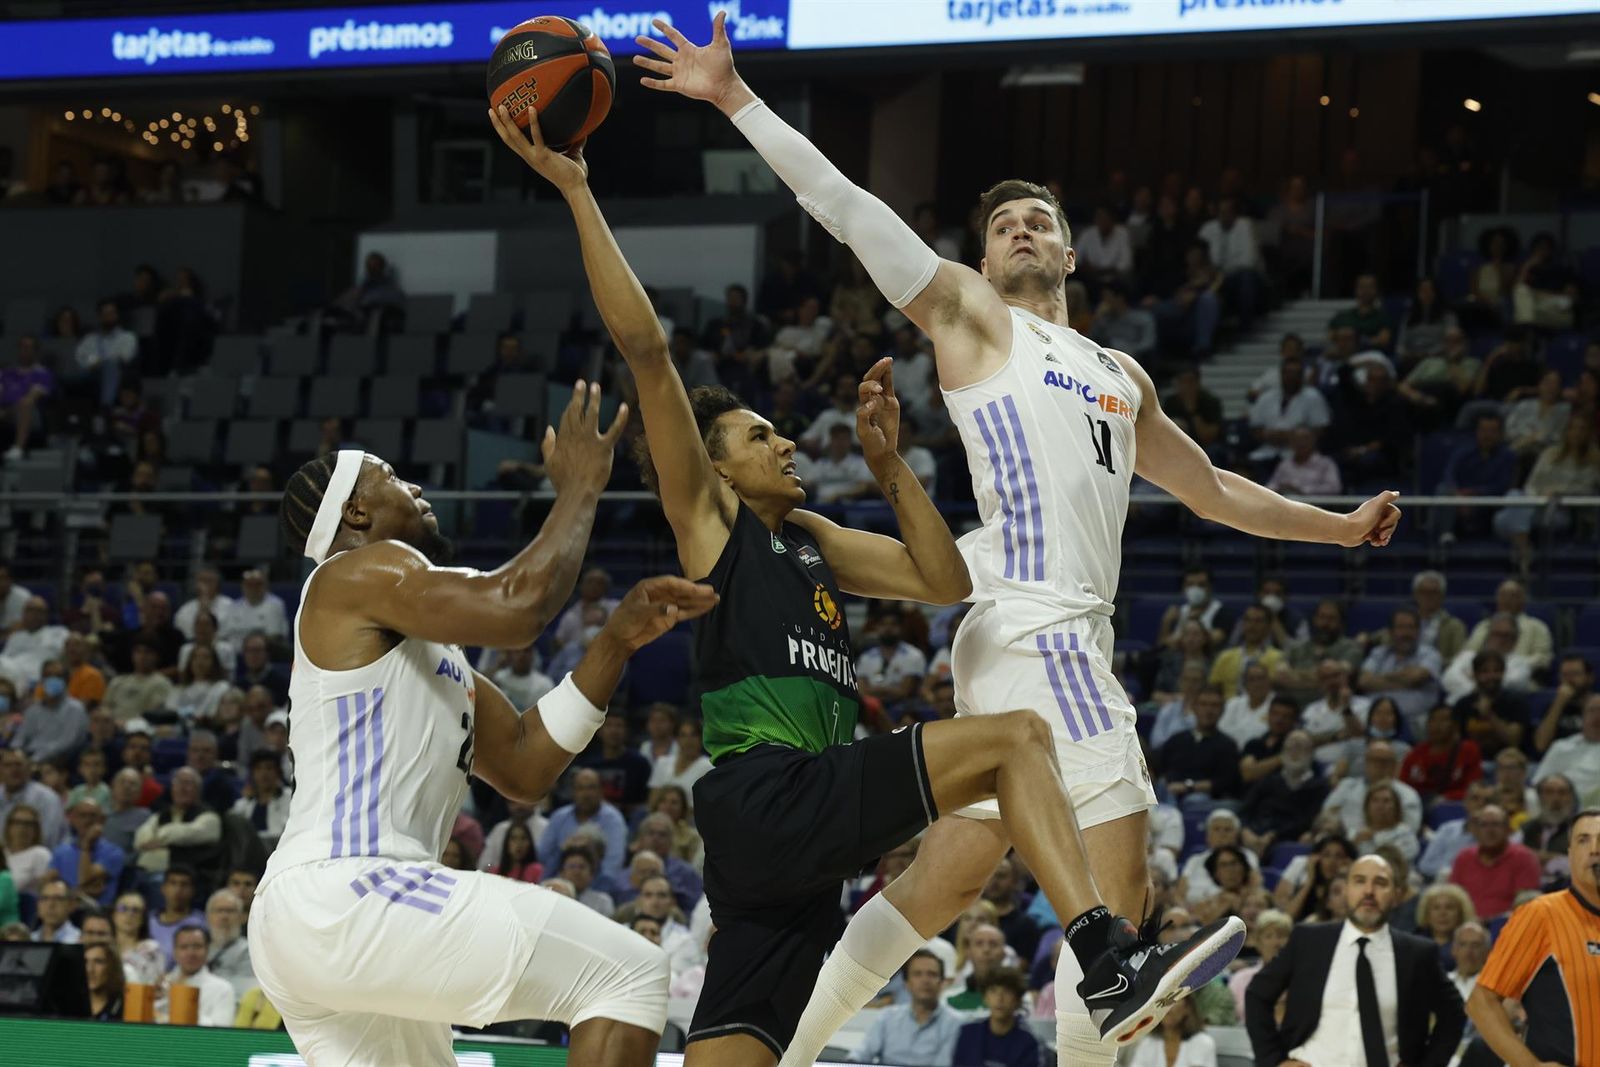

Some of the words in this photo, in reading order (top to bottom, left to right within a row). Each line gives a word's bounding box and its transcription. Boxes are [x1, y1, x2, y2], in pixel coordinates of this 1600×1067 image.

[948, 0, 1056, 26] tarjetas
[112, 27, 211, 65] tarjetas
[308, 18, 454, 59] préstamos
[1083, 411, 1116, 475] 11
